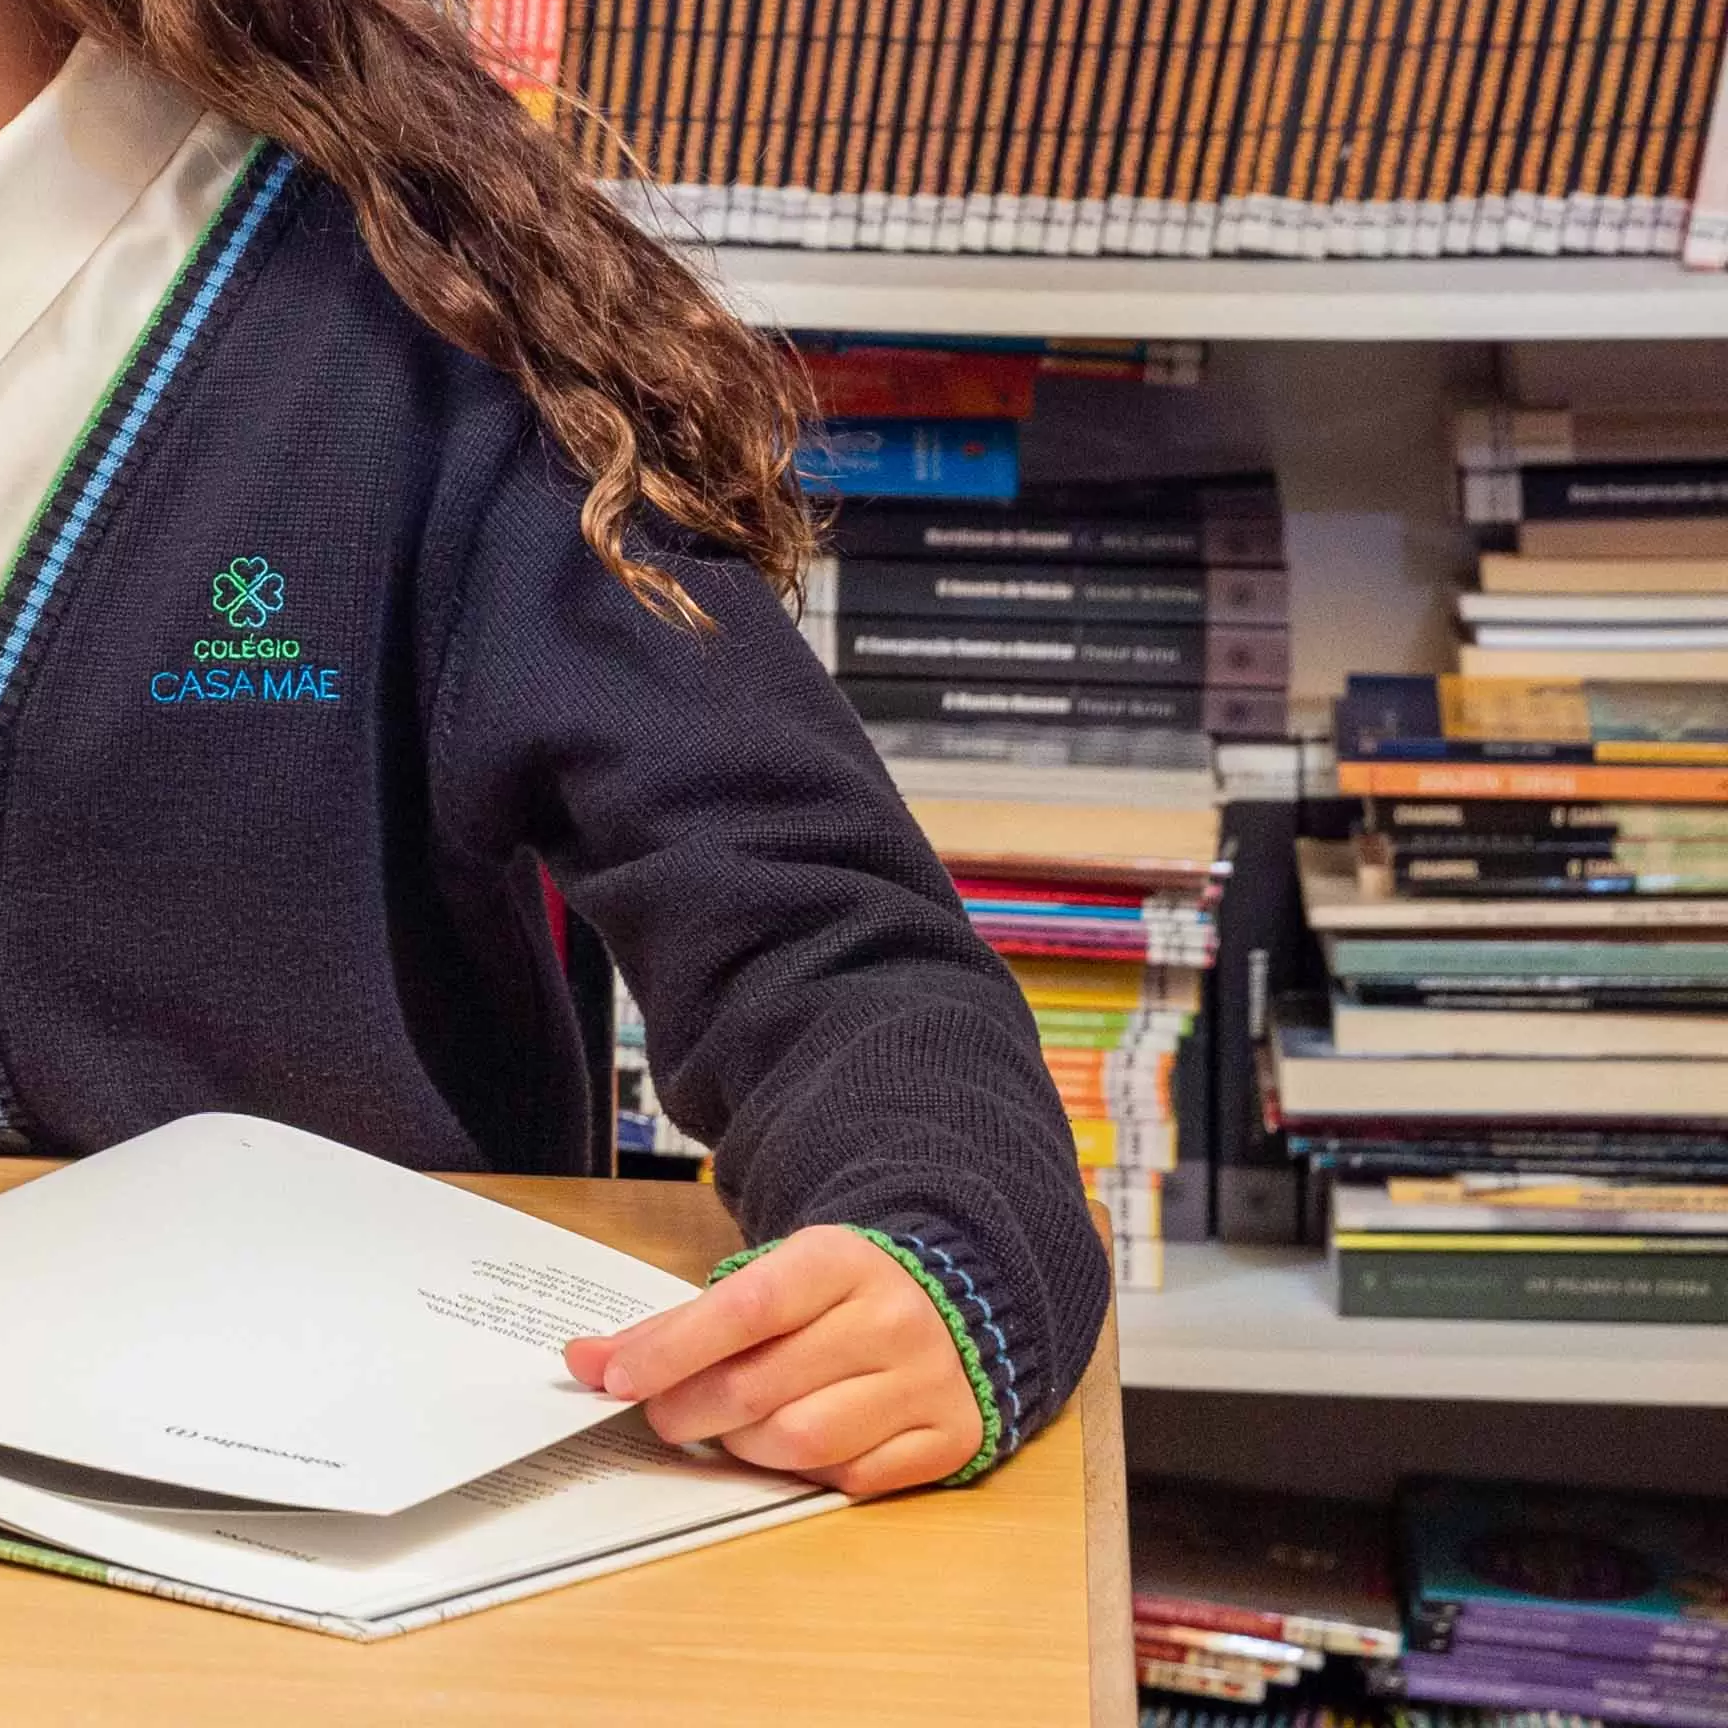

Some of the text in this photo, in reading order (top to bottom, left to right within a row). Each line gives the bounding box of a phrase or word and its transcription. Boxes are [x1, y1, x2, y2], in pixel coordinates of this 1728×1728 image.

[194, 634, 300, 661] COLÉGIO
[151, 664, 341, 702] CASA MÃE
